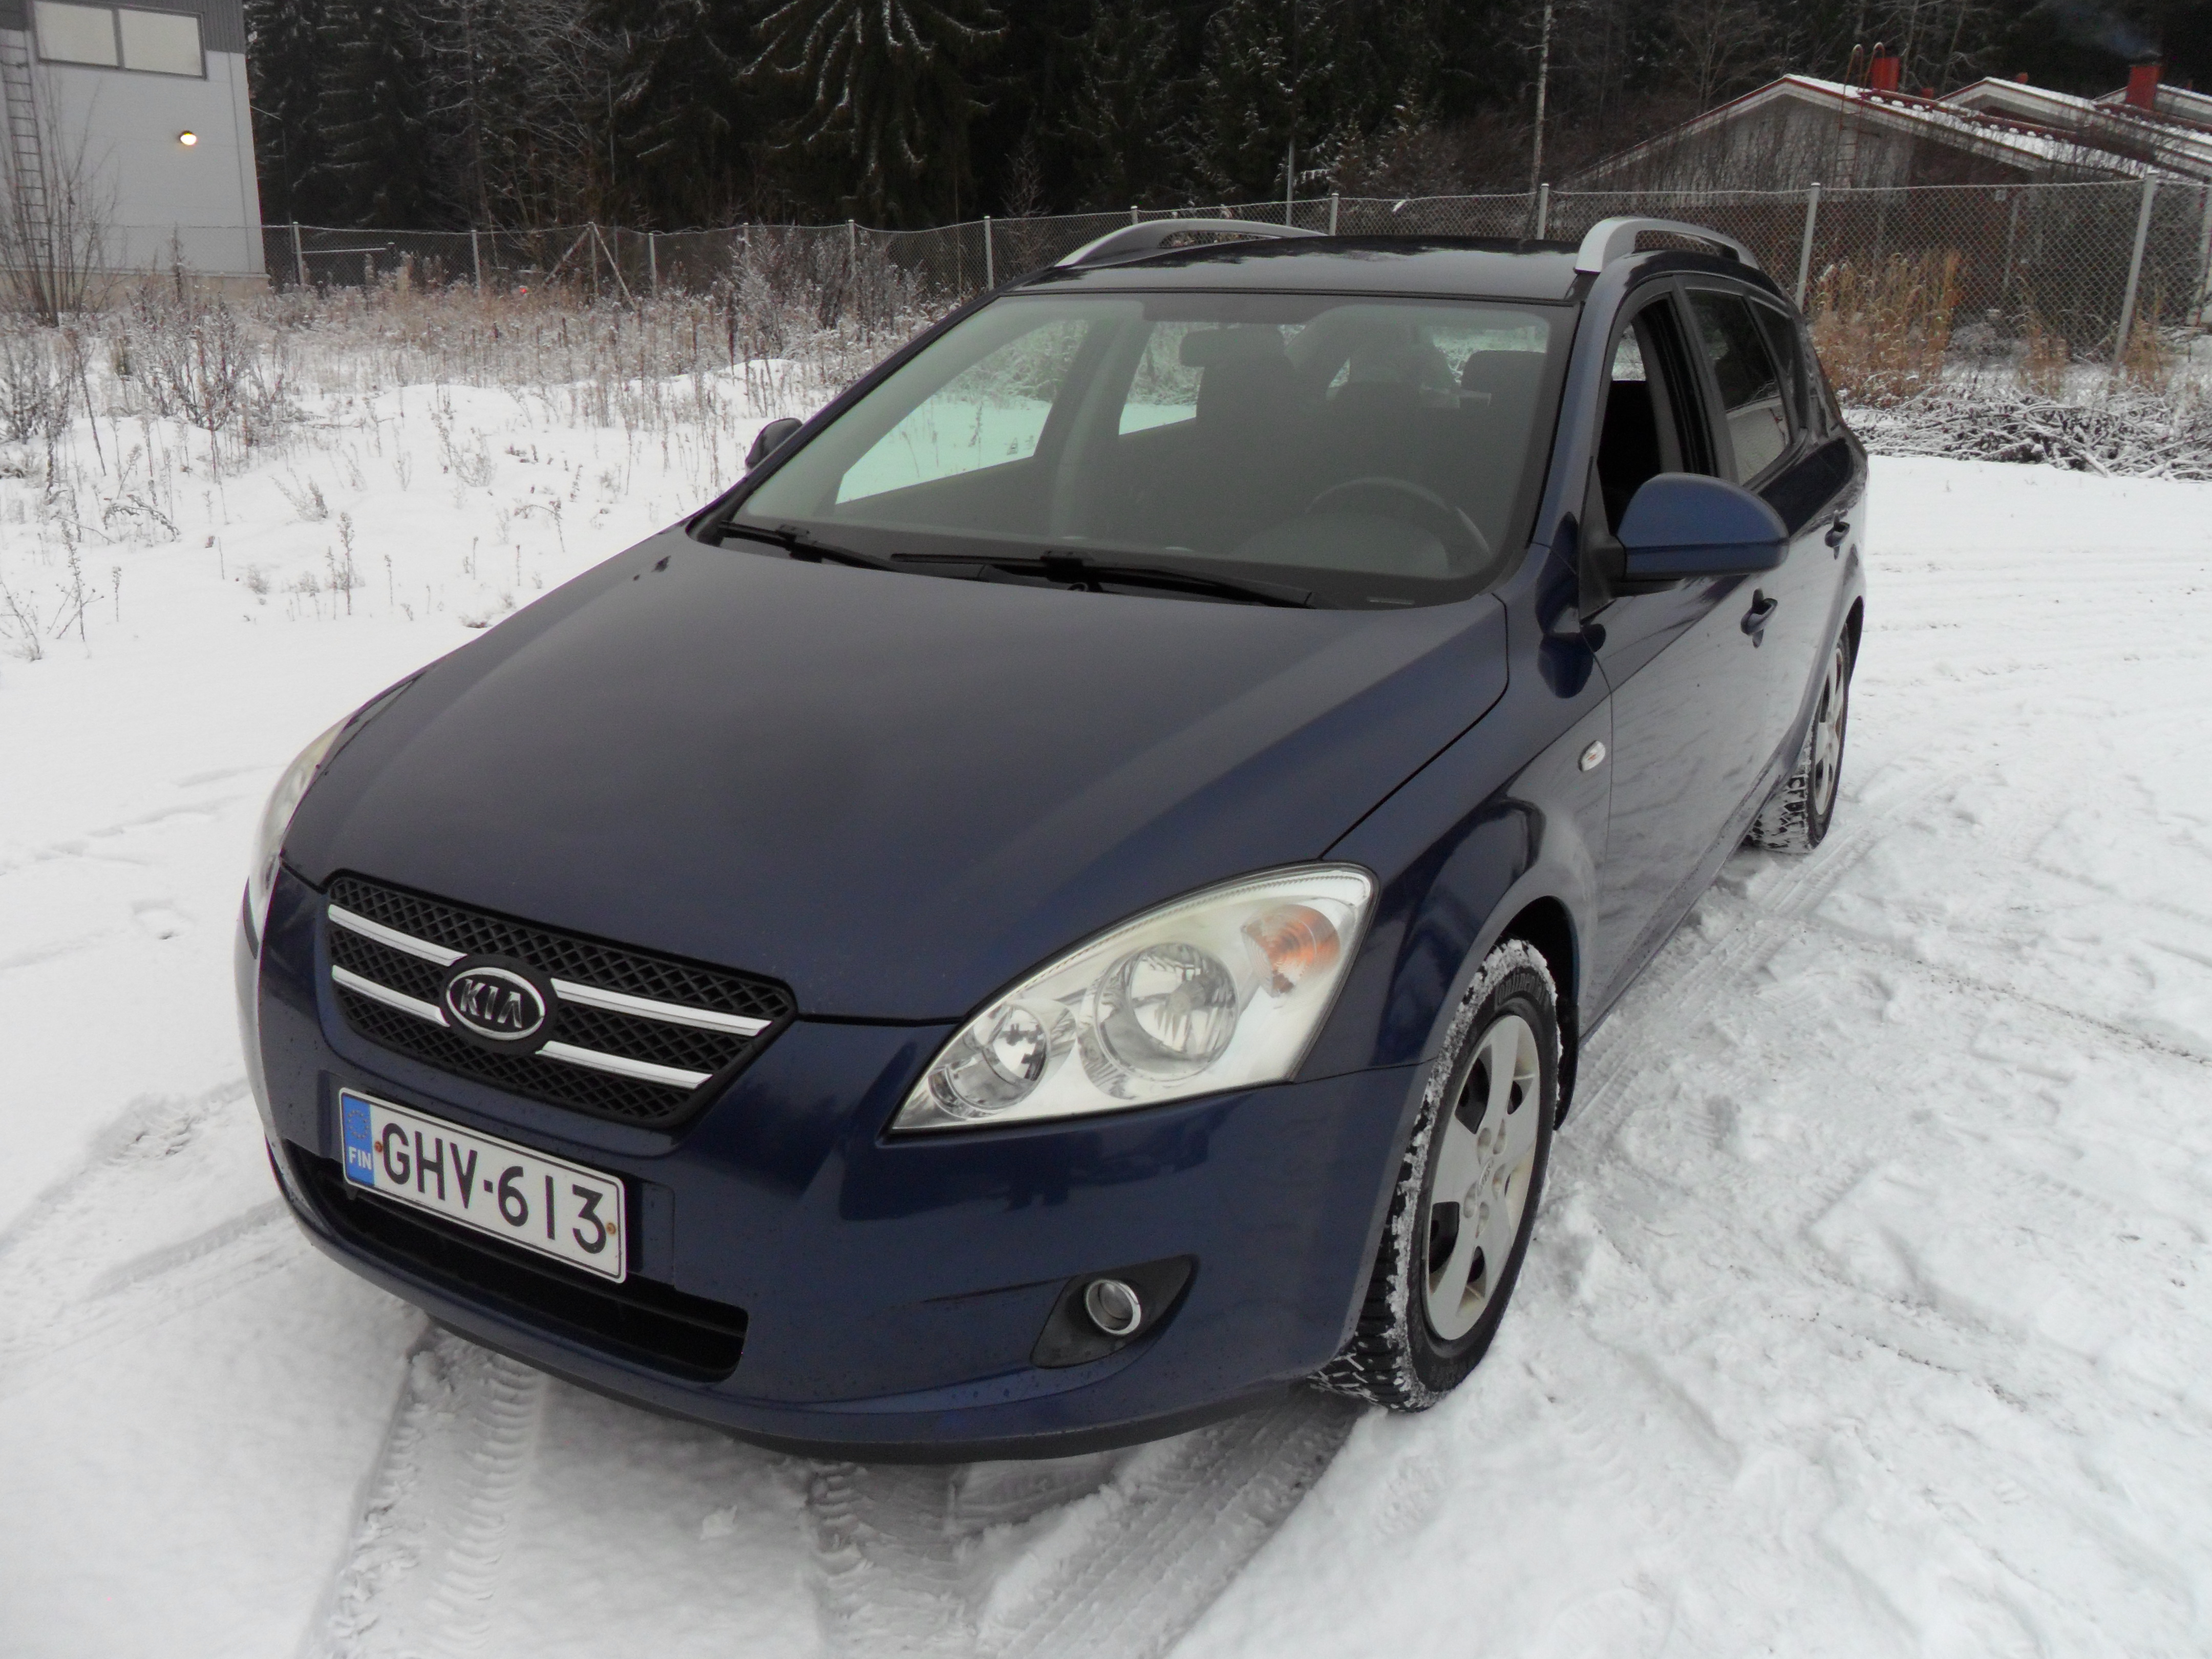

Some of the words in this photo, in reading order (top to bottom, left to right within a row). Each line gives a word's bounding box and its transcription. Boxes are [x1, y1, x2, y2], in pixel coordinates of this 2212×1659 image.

[460, 979, 523, 1029] KIA
[349, 1146, 372, 1170] FIN
[382, 1123, 607, 1254] GHV-613
